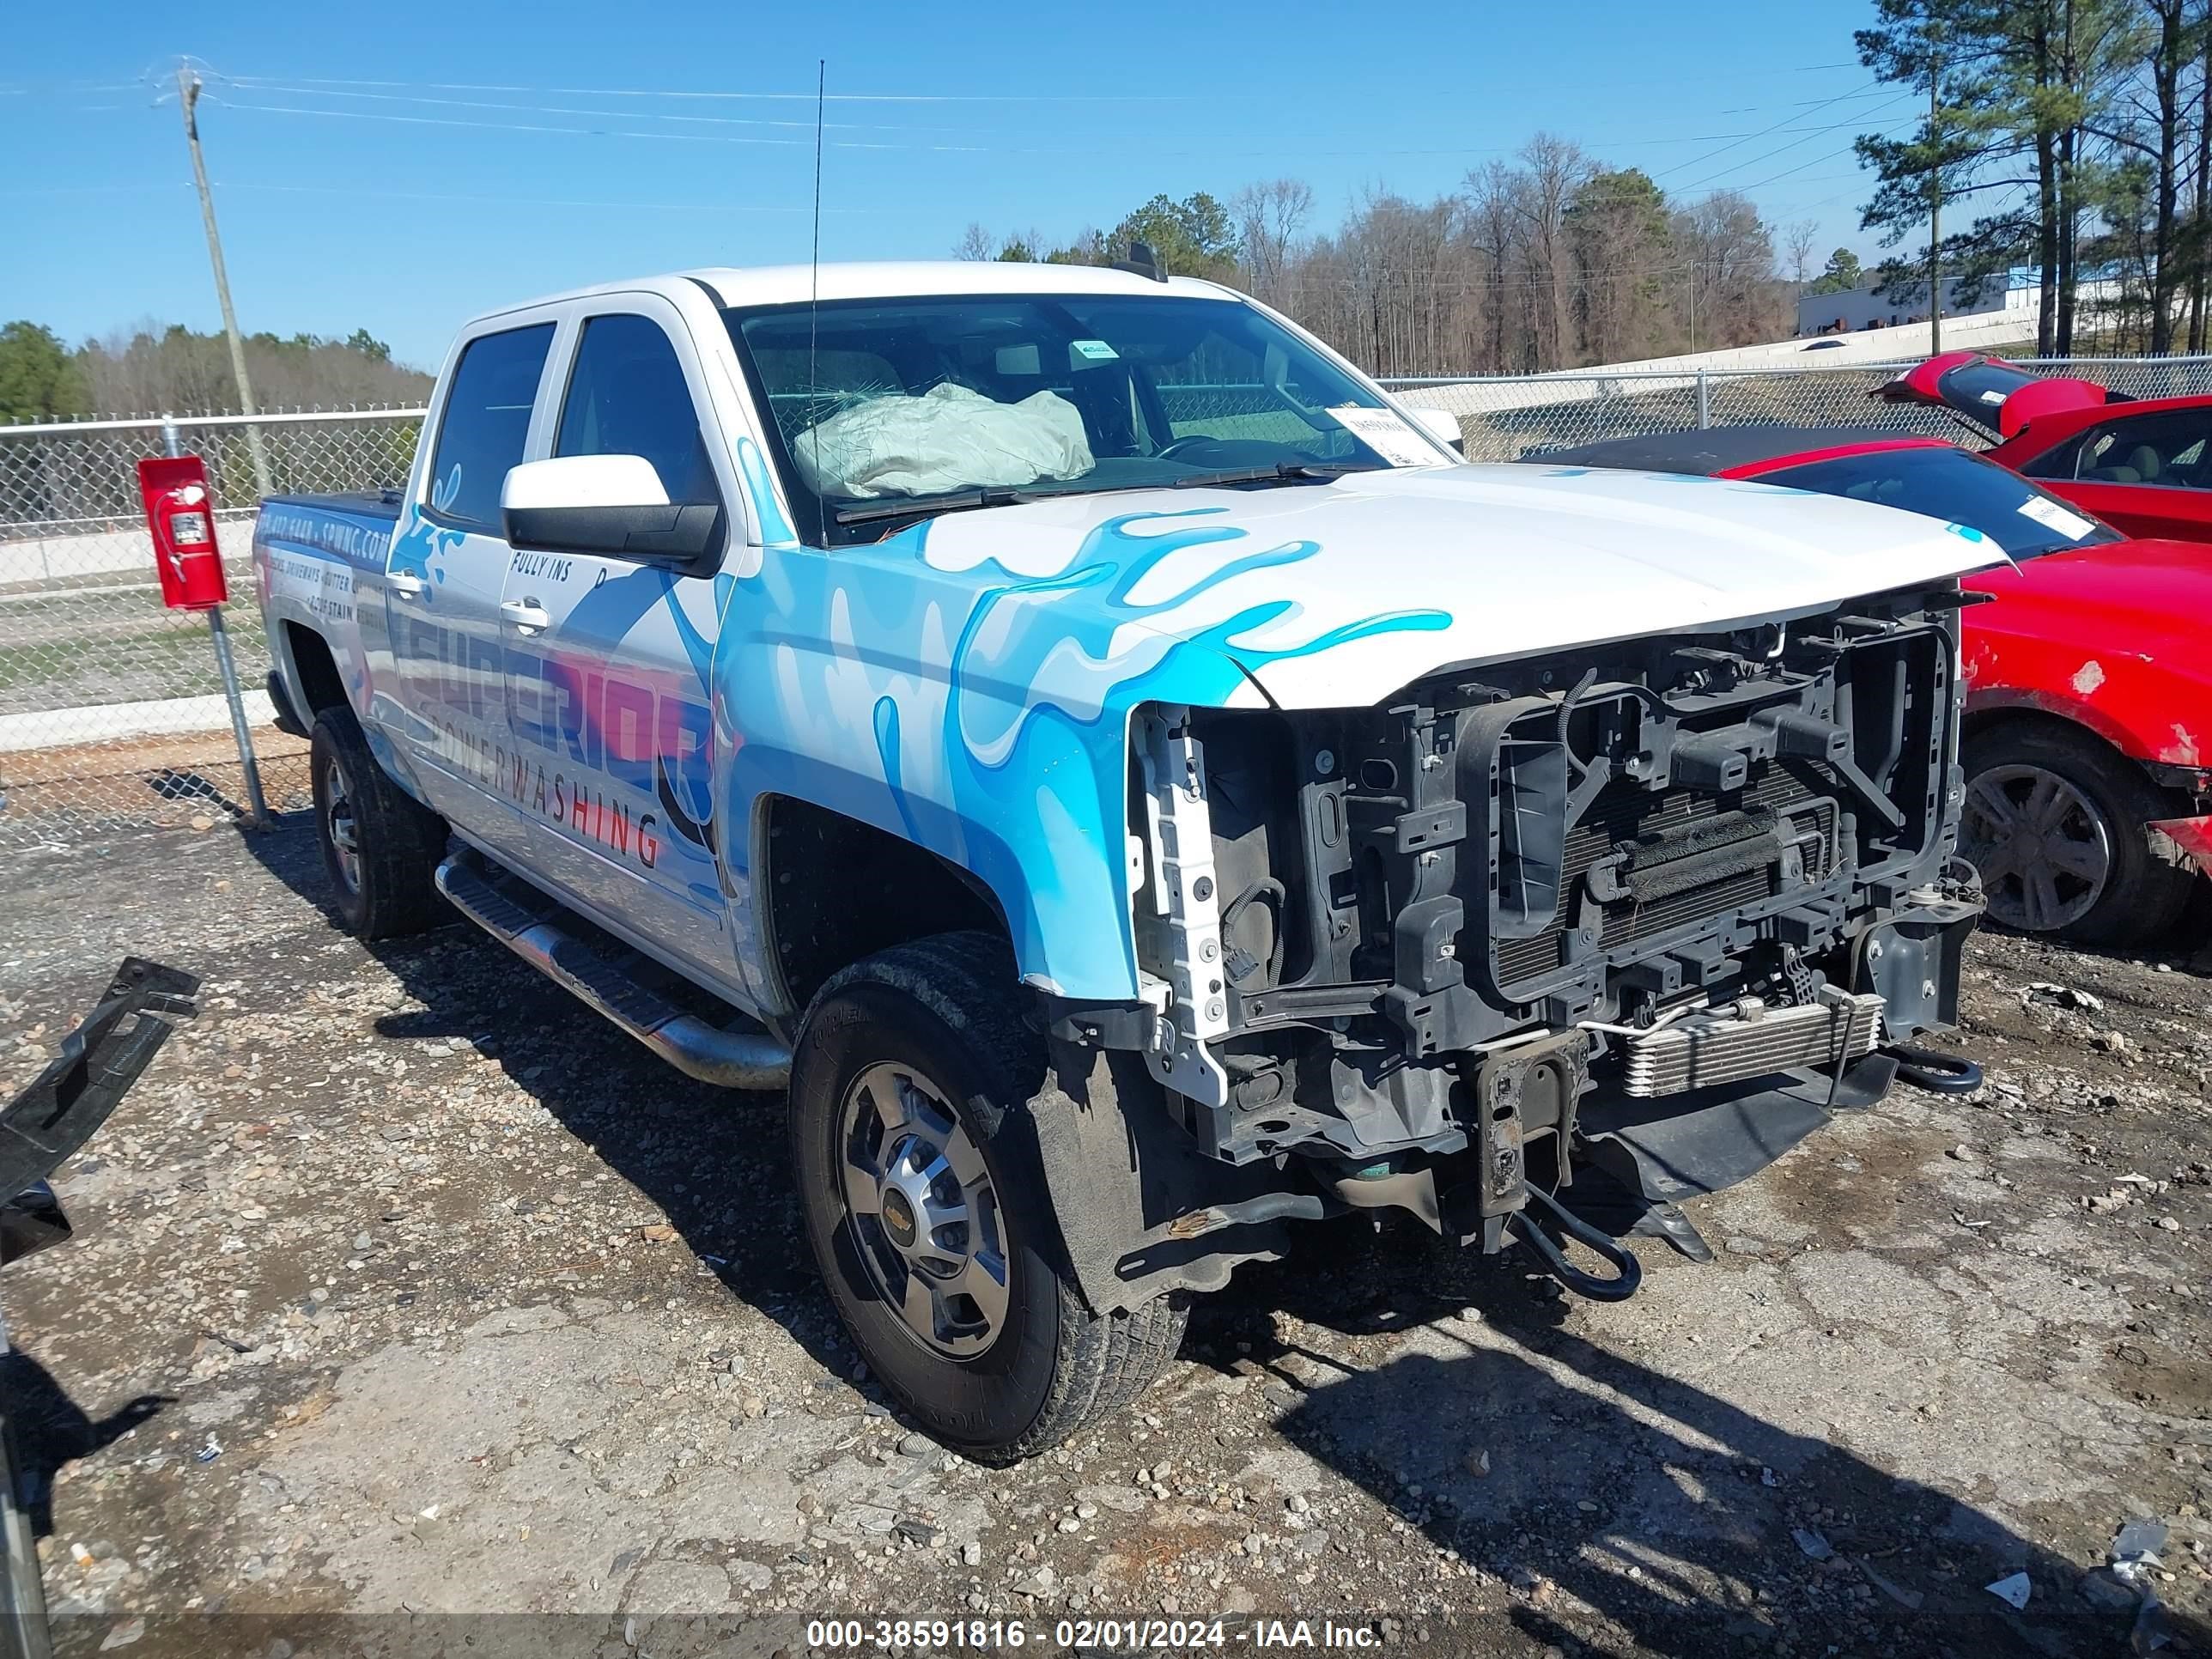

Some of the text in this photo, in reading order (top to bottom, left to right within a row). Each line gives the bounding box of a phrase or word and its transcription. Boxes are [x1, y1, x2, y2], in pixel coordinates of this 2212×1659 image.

[510, 551, 549, 577] FULLY
[328, 600, 353, 622] STAIN
[406, 617, 715, 823] SUPERIOR
